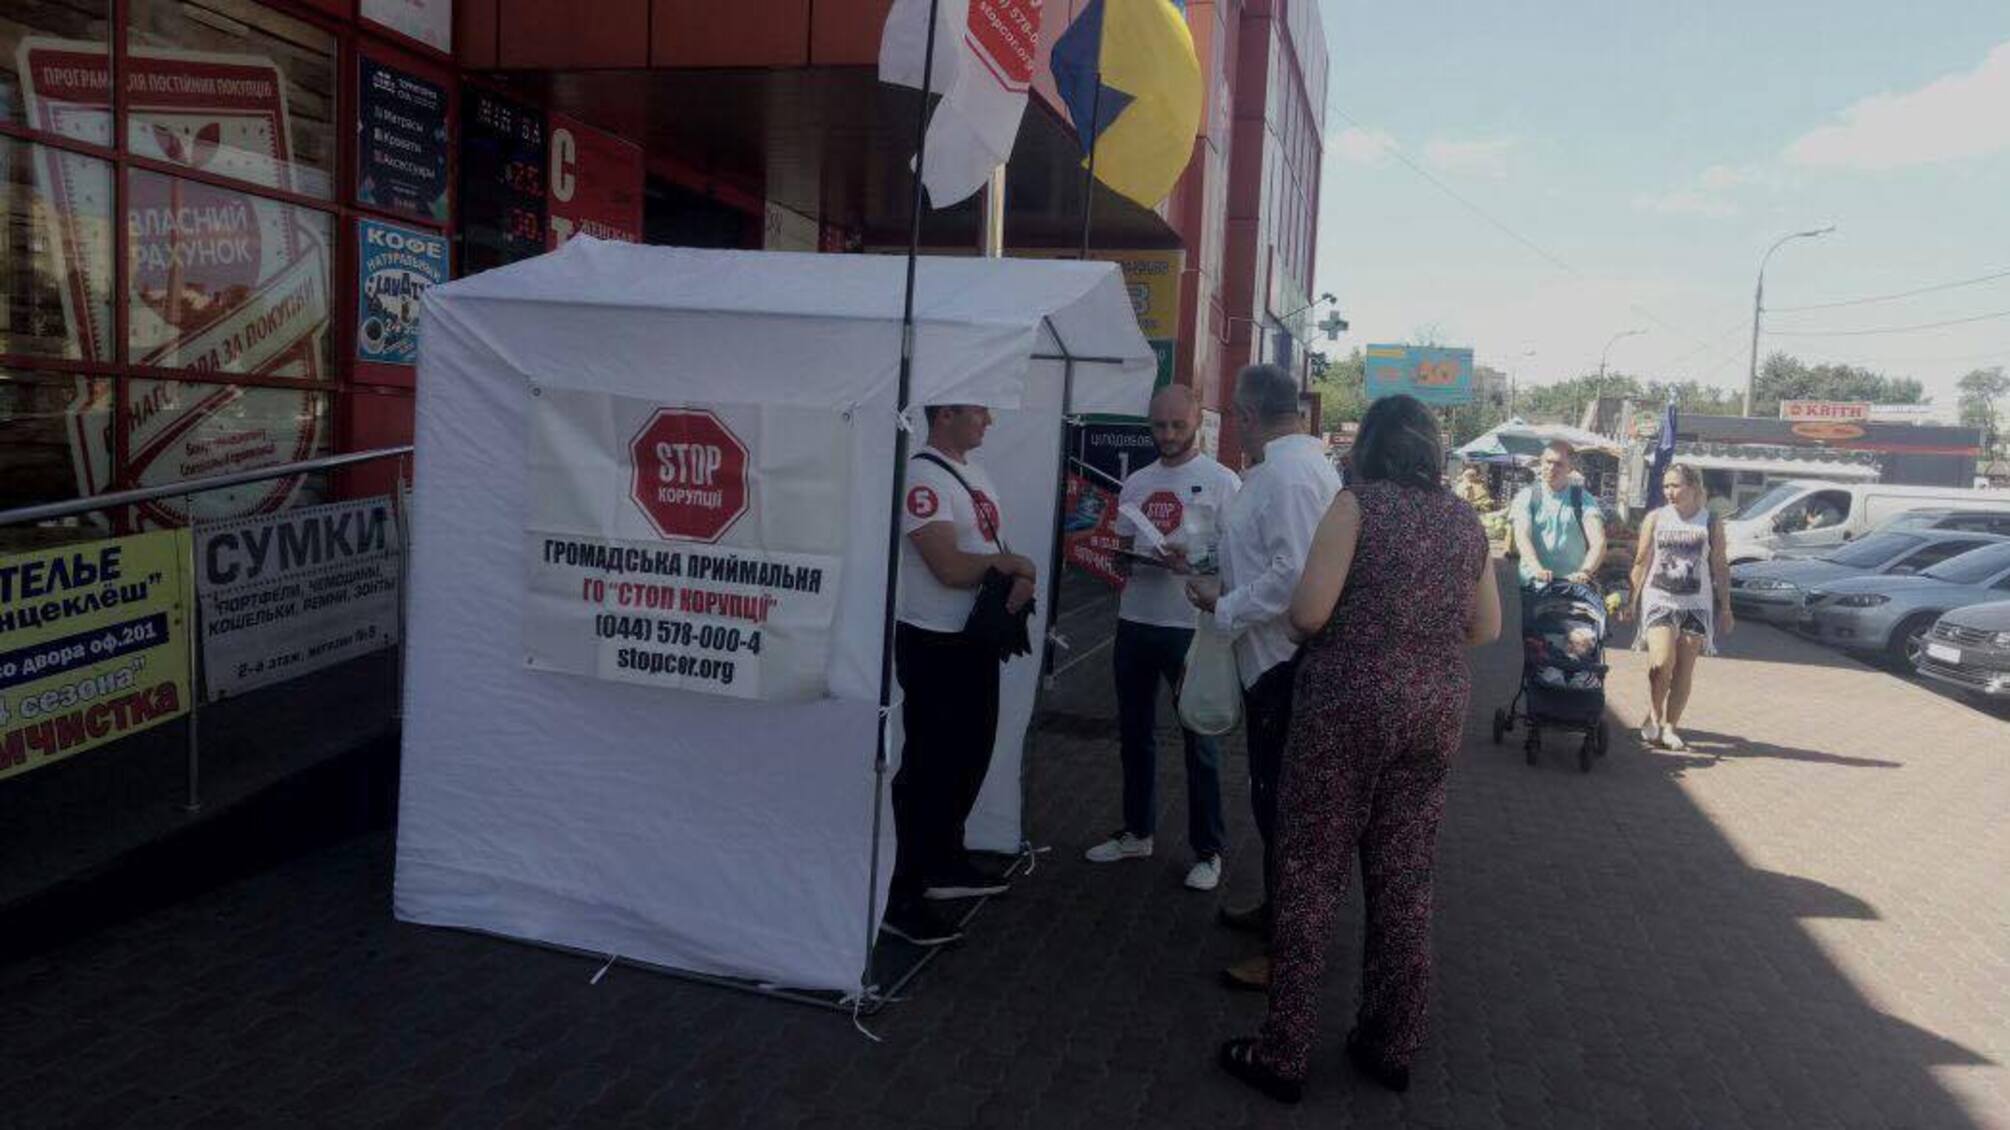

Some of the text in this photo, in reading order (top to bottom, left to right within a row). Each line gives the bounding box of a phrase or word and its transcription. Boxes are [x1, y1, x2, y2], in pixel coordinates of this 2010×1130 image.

[129, 201, 247, 237] ВЛАСНИЙ
[366, 227, 444, 259] КОФЕ
[655, 440, 722, 487] STOP
[657, 487, 724, 511] КОРУПЦІЇ
[914, 490, 932, 514] 5
[1146, 502, 1176, 519] STOP
[206, 507, 386, 585] СУМКИ
[544, 540, 823, 595] ГРОМАДСЬКА ПРИЙМАЛЬНЯ
[582, 577, 604, 604] ГО
[21, 642, 87, 676] двора
[89, 621, 158, 654] оф.201
[596, 614, 761, 655] (044) 578-000-4
[617, 648, 736, 685] stopcor.org
